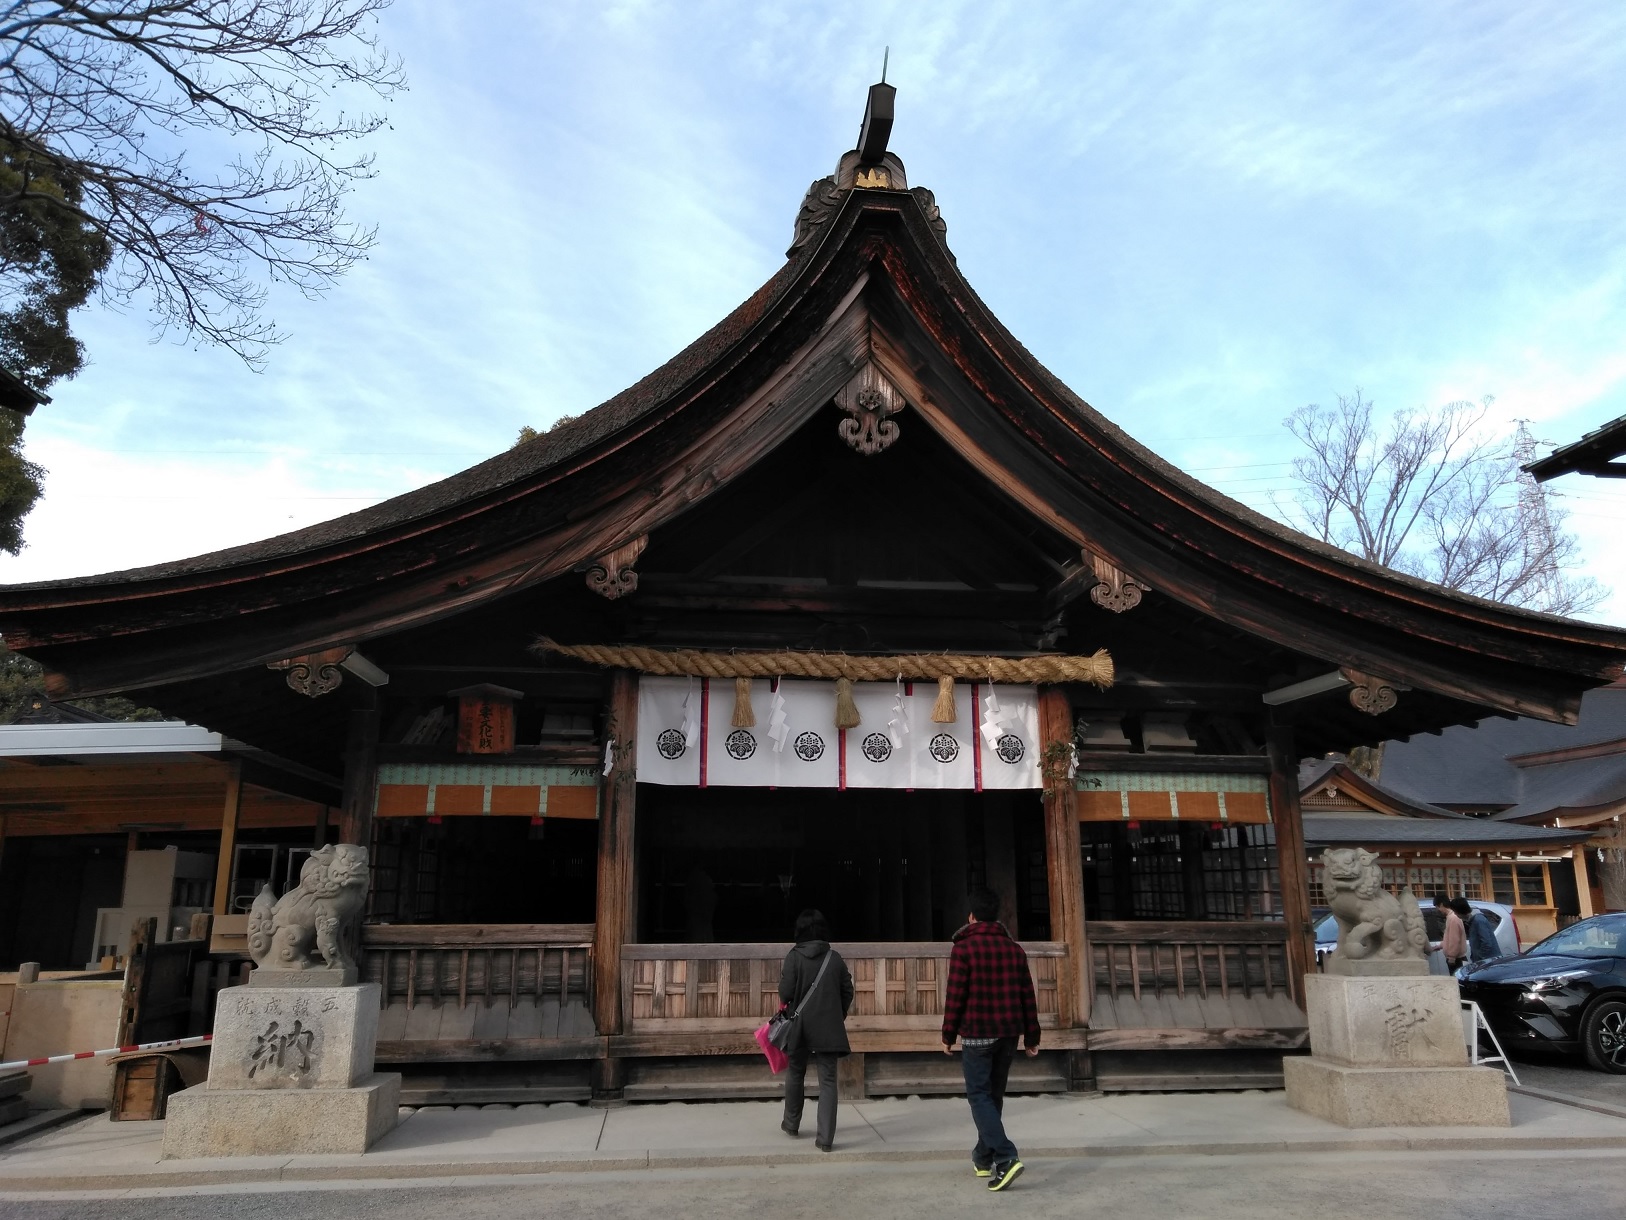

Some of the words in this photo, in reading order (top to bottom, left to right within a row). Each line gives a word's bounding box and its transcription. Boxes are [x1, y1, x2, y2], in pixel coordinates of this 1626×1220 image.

[478, 697, 494, 749] 要文化財
[249, 1020, 319, 1079] 納
